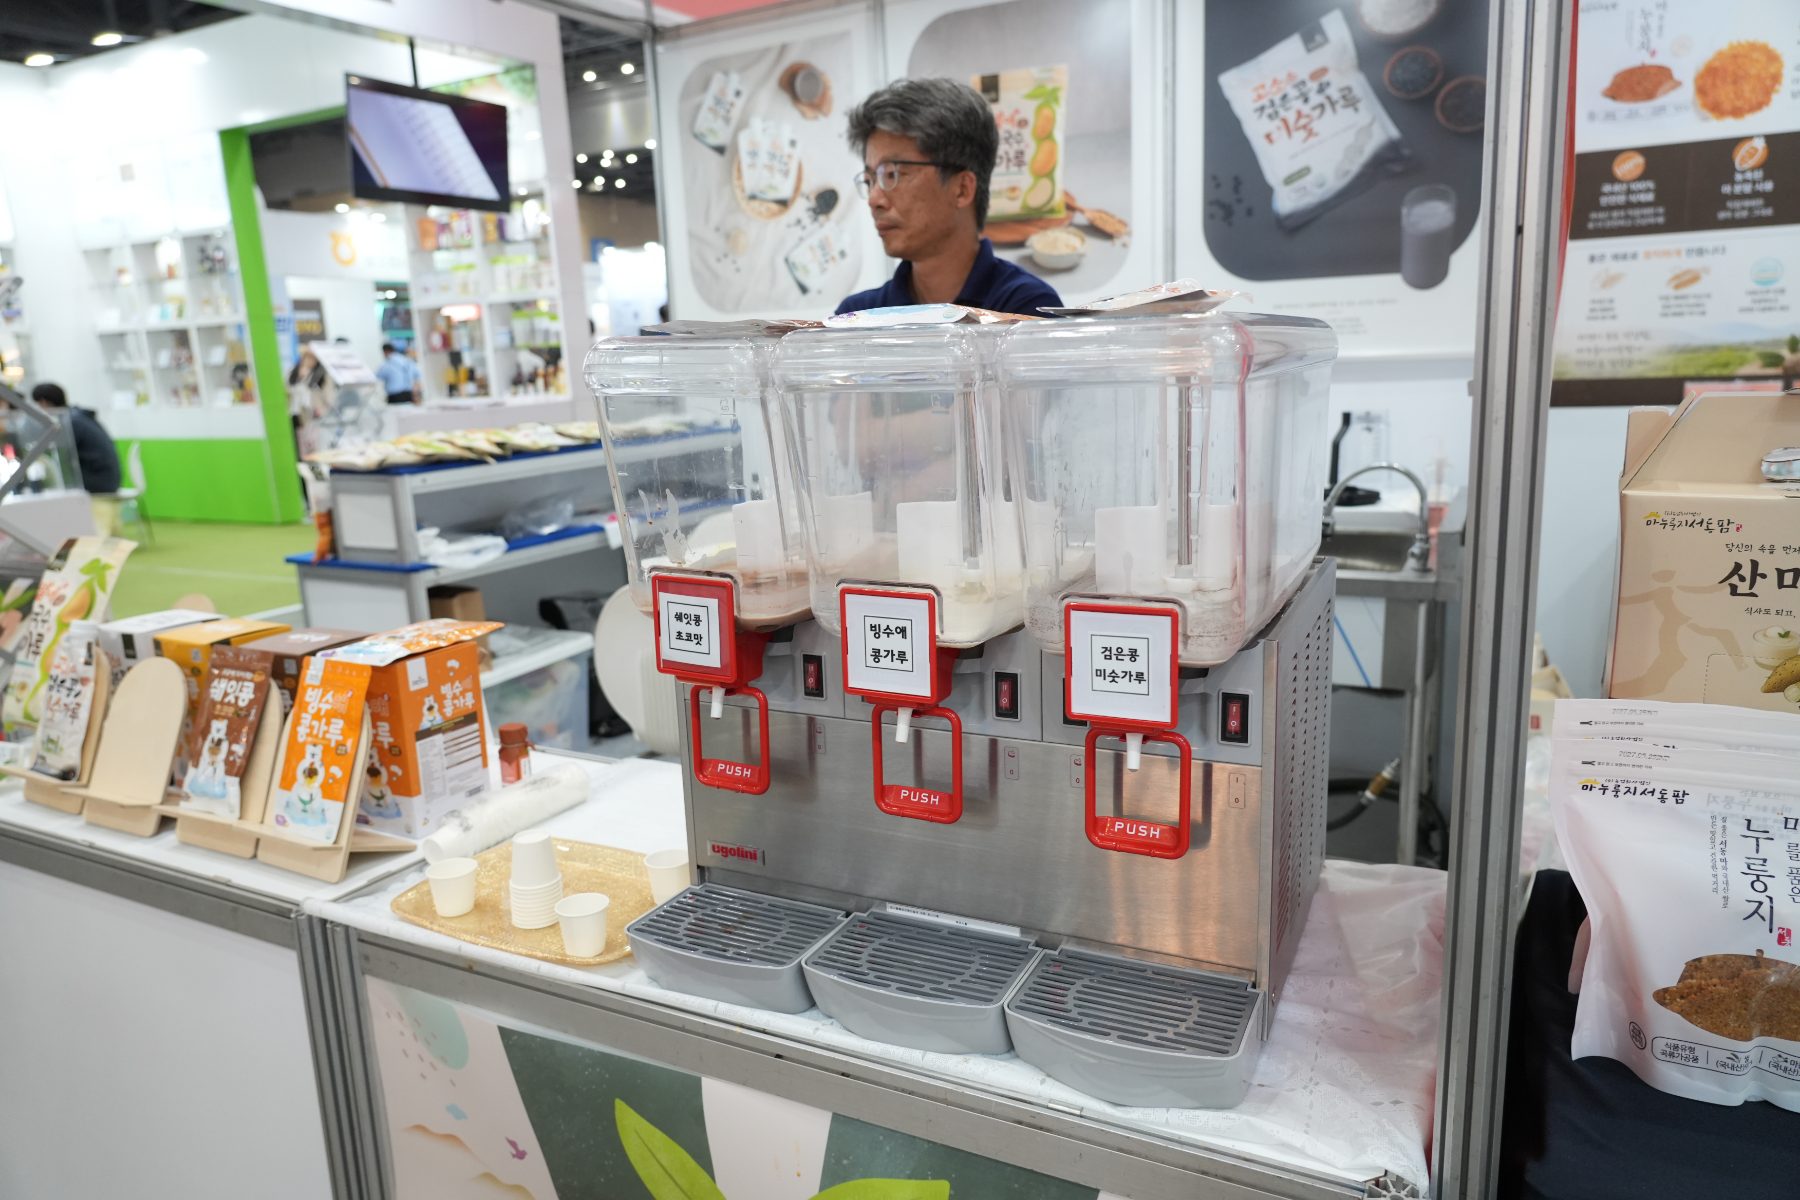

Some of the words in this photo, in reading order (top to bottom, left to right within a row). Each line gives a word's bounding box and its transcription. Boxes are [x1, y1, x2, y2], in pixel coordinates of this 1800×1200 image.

[1725, 542, 1753, 553] 당신의
[1758, 543, 1776, 555] 속을
[674, 611, 703, 627] 쉐잇콩
[1744, 606, 1772, 617] 식사도
[675, 630, 703, 646] 초코맛
[869, 647, 909, 665] 콩가루
[1100, 646, 1140, 663] 검은콩
[1095, 668, 1147, 685] 미숫가루
[442, 691, 475, 717] 콩가루
[296, 712, 345, 748] 콩가루
[717, 763, 752, 779] PUSH
[900, 789, 940, 806] PUSH
[1581, 783, 1690, 805] 마누룽지서동팜
[1114, 821, 1161, 839] PUSH
[711, 842, 758, 862] ugolini
[1740, 818, 1776, 934] 누룽지
[1664, 1041, 1696, 1055] 식품유형
